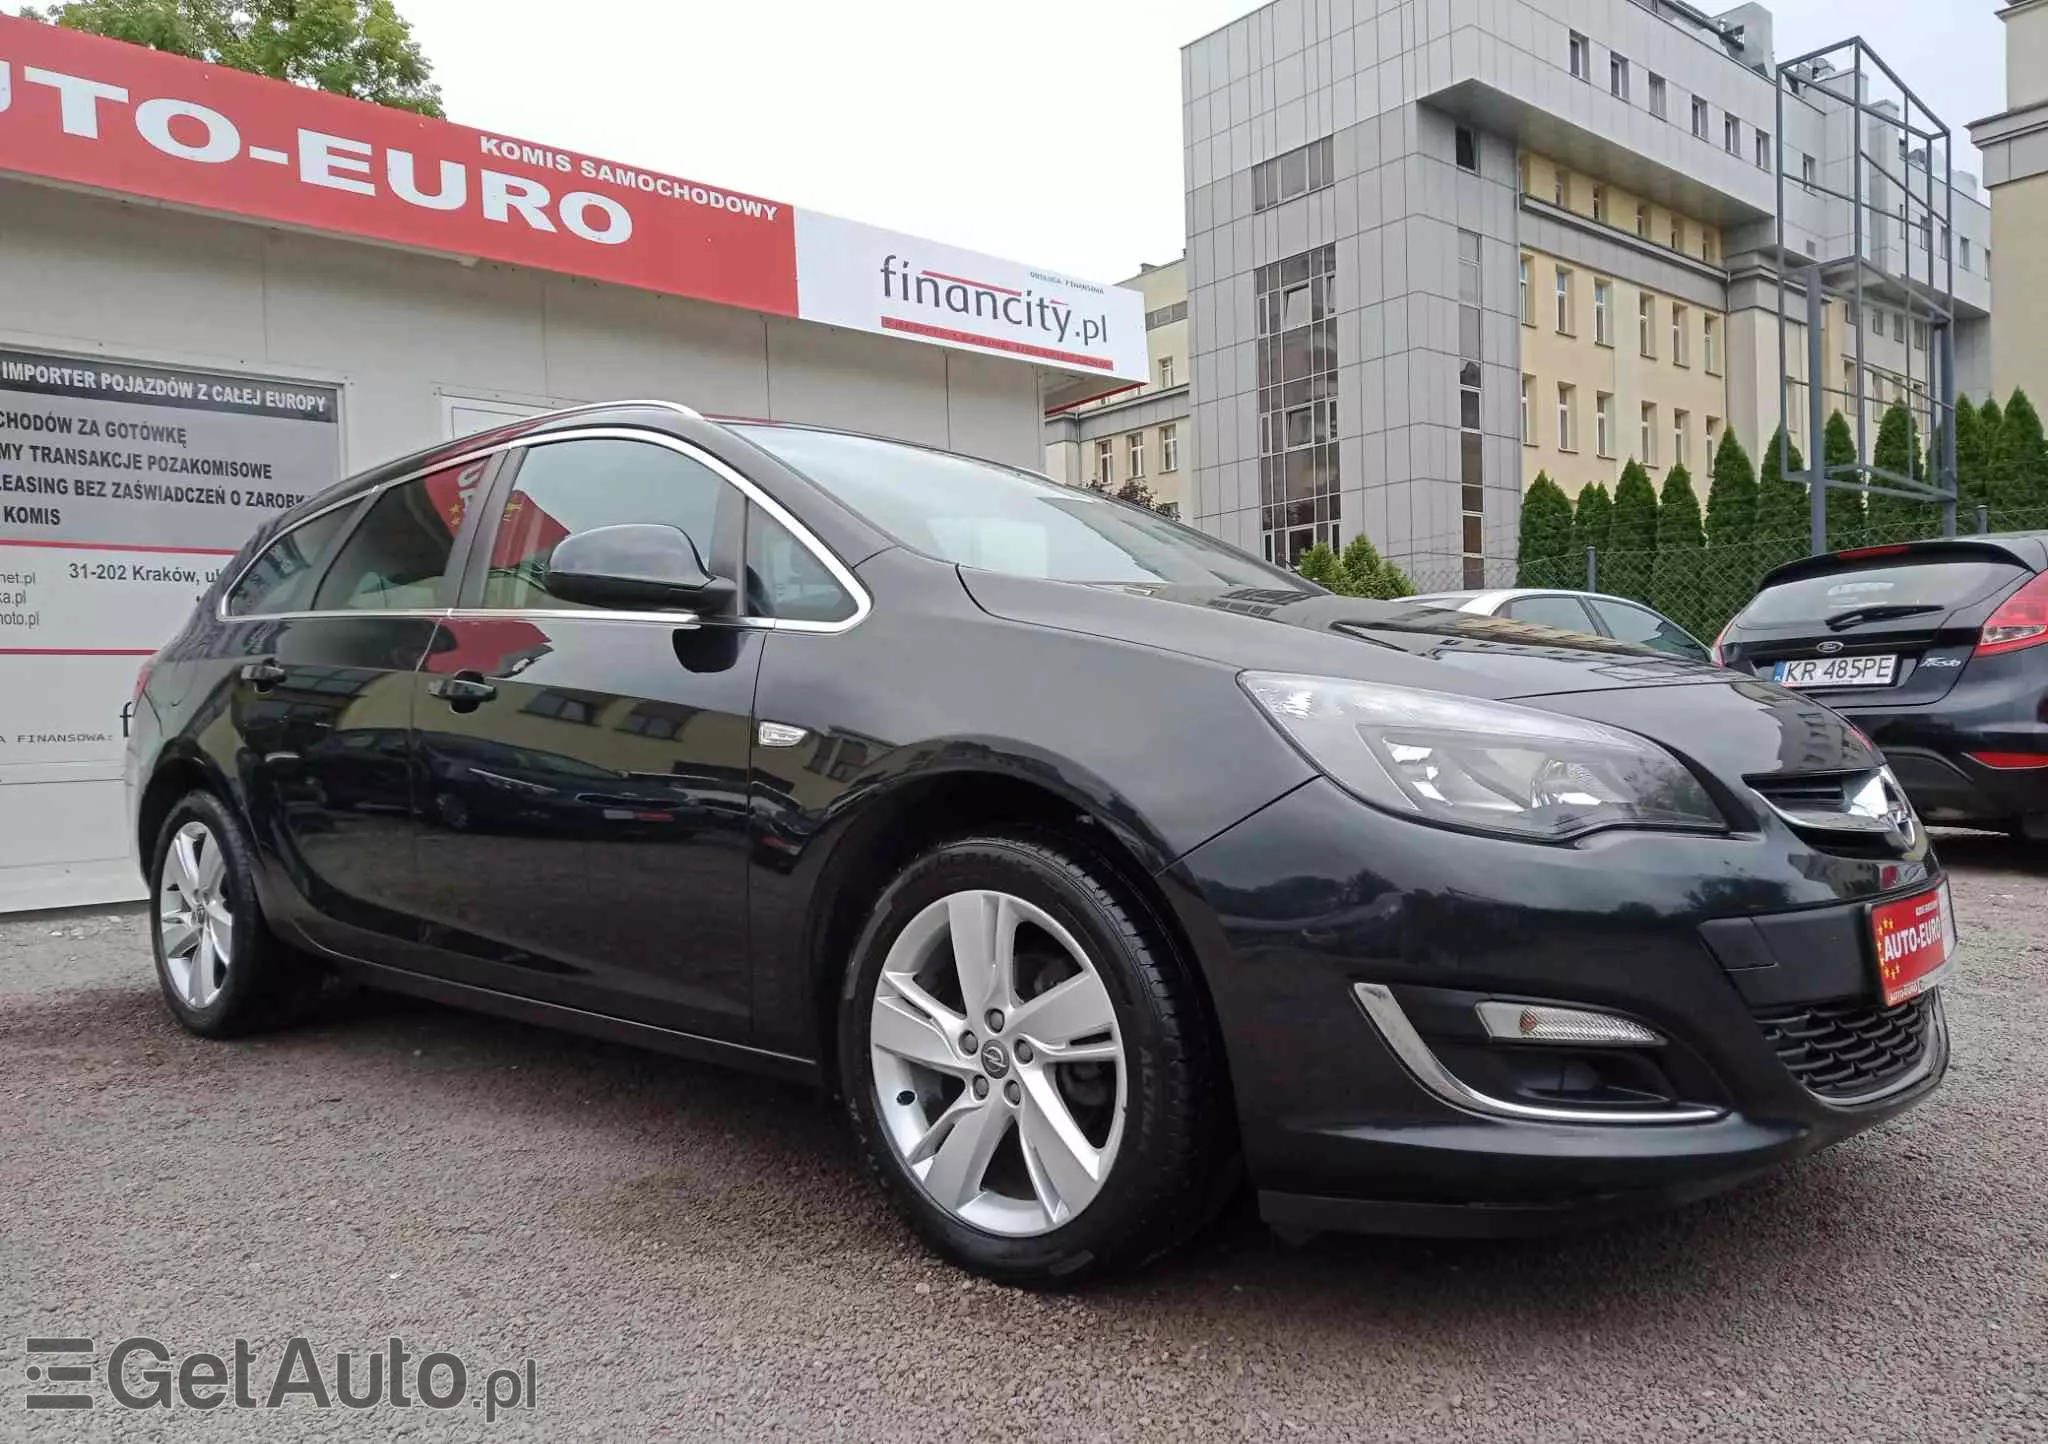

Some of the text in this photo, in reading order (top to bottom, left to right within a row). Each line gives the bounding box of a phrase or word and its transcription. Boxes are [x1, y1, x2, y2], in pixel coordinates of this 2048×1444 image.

[0, 59, 634, 246] TO-EURO
[479, 134, 778, 222] KOMIS SAMOCHODOWY
[879, 254, 1108, 346] financity.pl
[2, 360, 326, 413] IMPORTER POJAZDÓW Z CAŁEJ EUROPY
[77, 418, 101, 437] ZA
[105, 420, 187, 448] GOTÓWKĘ
[29, 445, 142, 470] TRANSAKCJE
[147, 454, 273, 480] POZAKOMISOWE
[0, 474, 68, 495] EASING
[74, 479, 107, 497] BEZ
[111, 480, 226, 505] ZAŚWIADCZEŃ
[231, 490, 241, 506] O
[3, 506, 61, 526] KOMIS
[69, 562, 127, 581] 31-202
[132, 564, 200, 585] Kraków,
[1785, 657, 1893, 682] KR 485PE
[1884, 917, 1942, 962] AUTO-EURO
